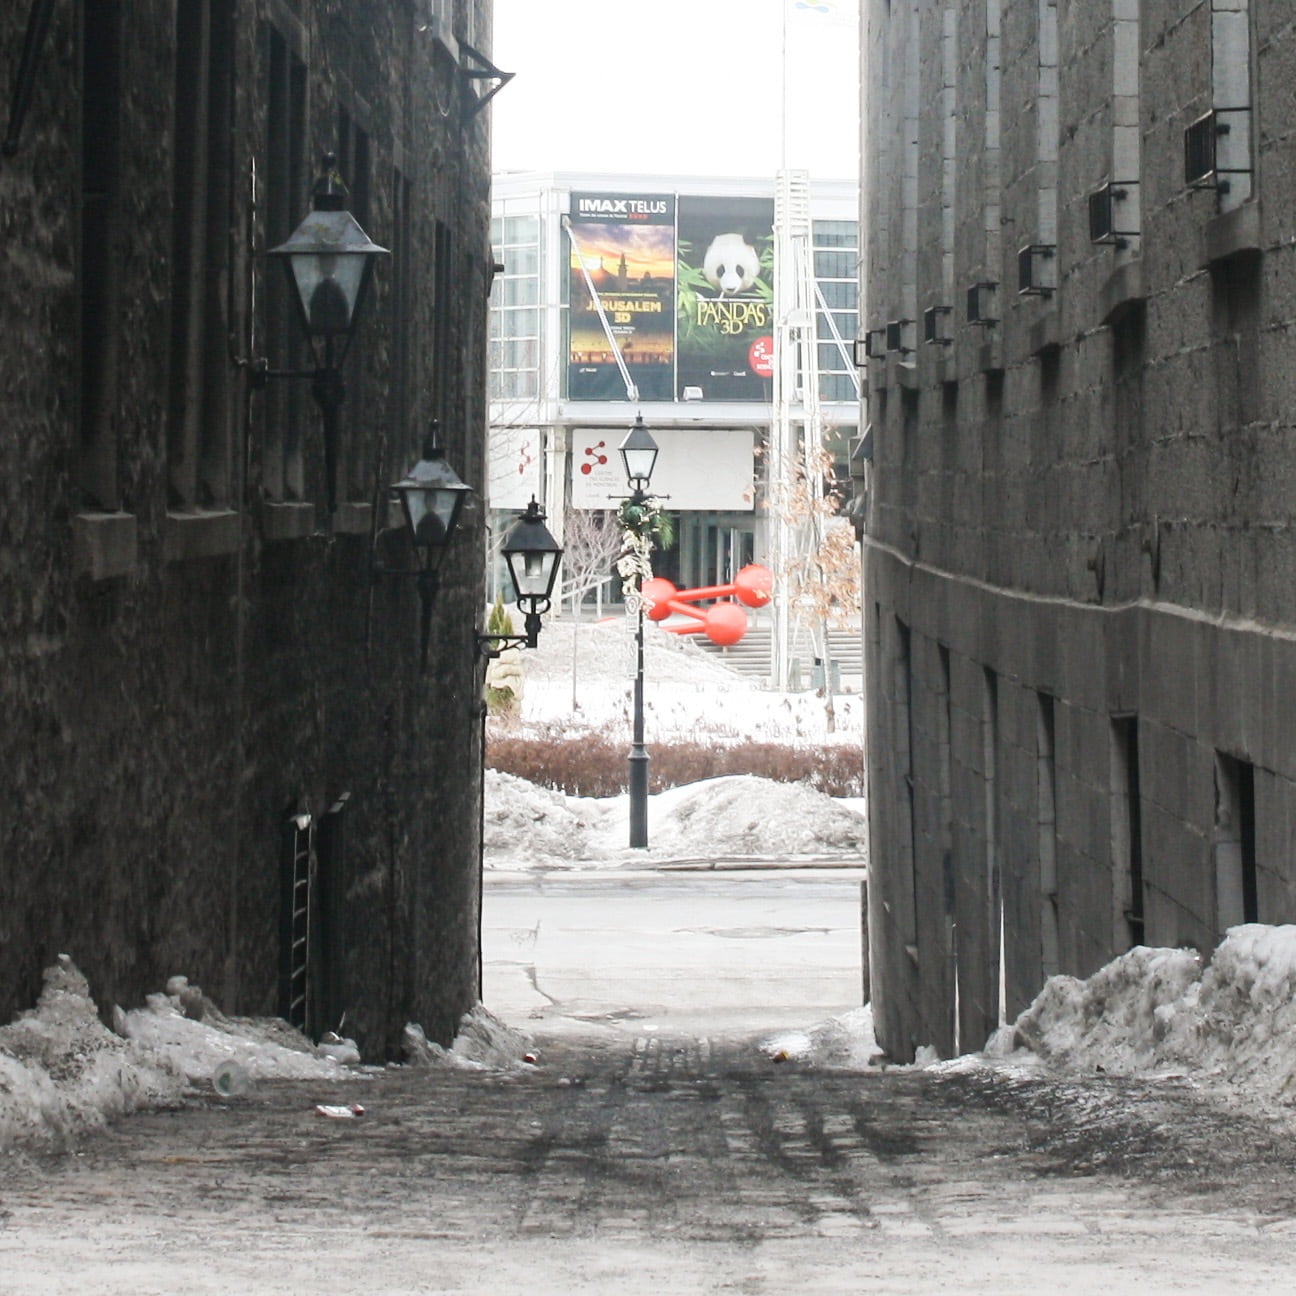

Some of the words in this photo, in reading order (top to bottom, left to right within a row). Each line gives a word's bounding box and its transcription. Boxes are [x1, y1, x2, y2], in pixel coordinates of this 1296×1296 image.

[579, 199, 628, 212] IMAX
[629, 200, 667, 213] TELUS
[614, 312, 631, 323] 3D
[697, 302, 765, 327] PANDAS
[720, 319, 743, 335] 3D
